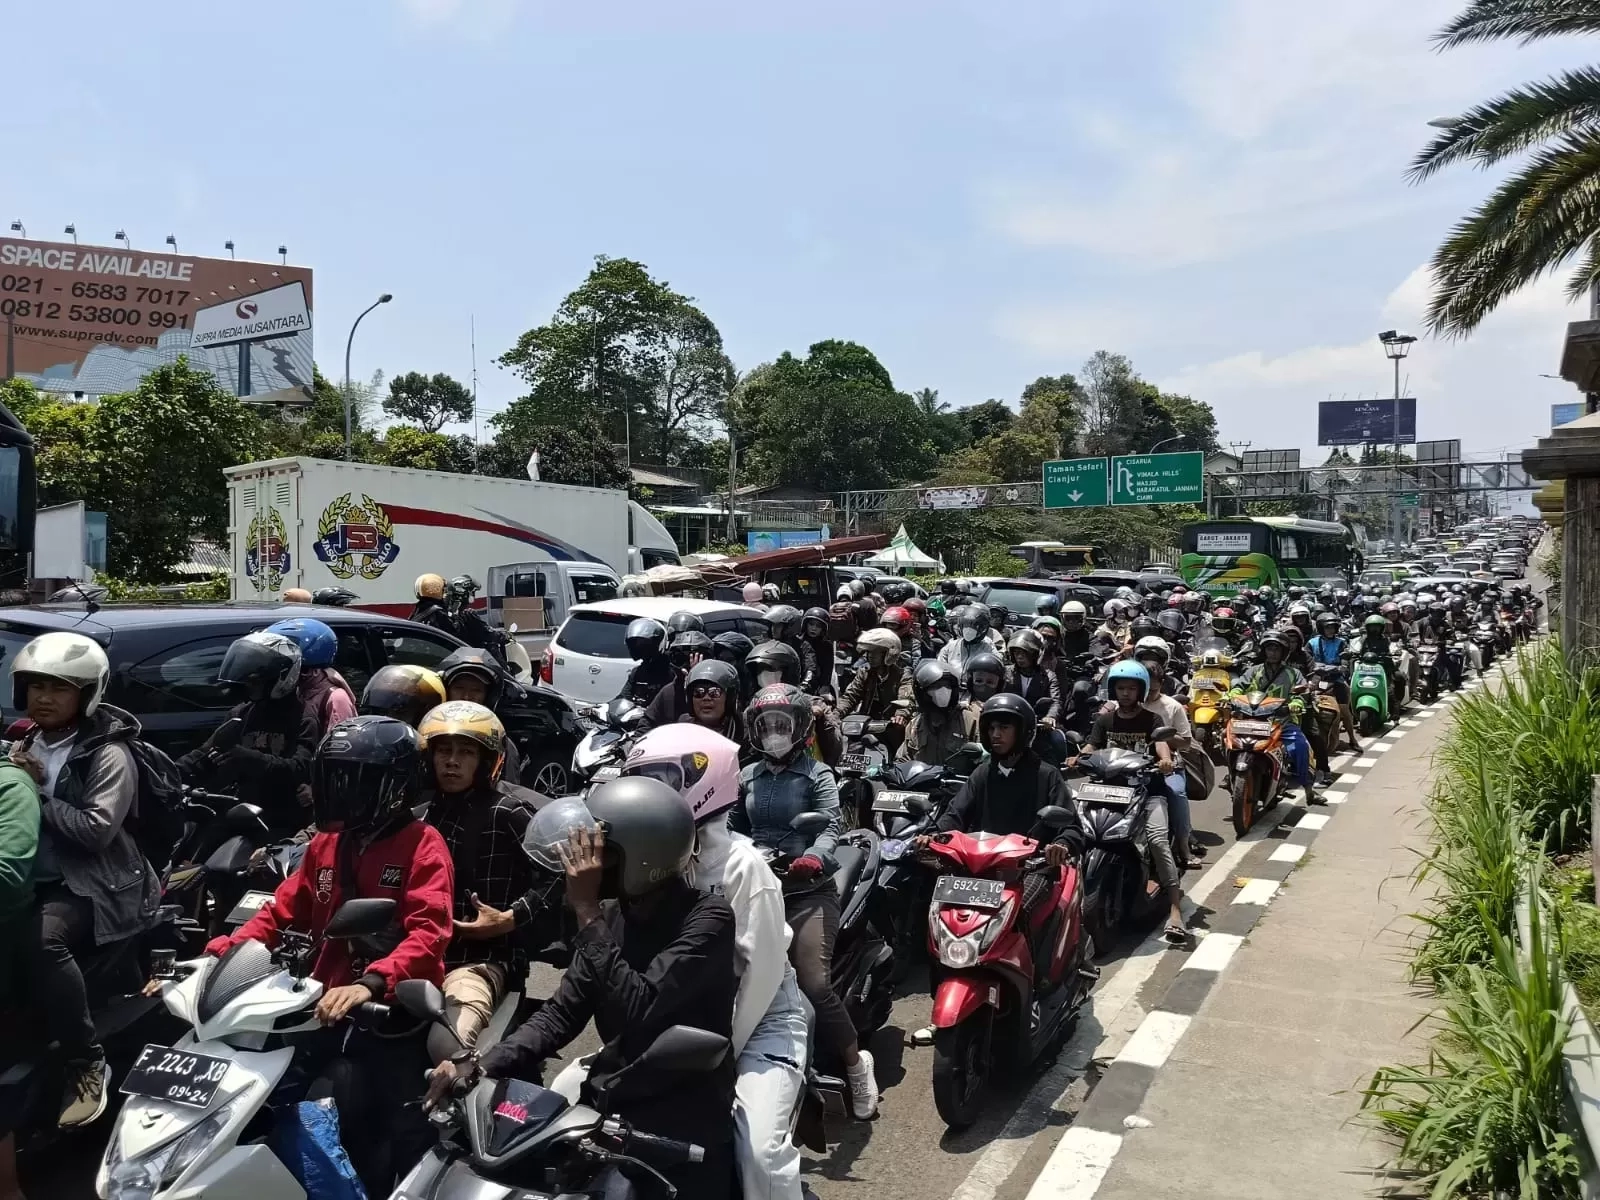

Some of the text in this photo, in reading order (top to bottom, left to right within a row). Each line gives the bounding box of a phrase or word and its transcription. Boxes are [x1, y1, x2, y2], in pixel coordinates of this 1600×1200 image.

[0, 244, 194, 282] SPACE AVAILABLE
[1, 275, 44, 294] 021
[71, 281, 127, 302] 6583
[136, 287, 191, 306] 7017
[0, 298, 189, 330] 0812 53800 991
[195, 314, 304, 343] SUPRA MEDIA NUSANTARA
[14, 325, 158, 345] www.supradv.com
[1048, 474, 1080, 484] Cianjur
[1077, 462, 1103, 471] Safari
[938, 878, 1003, 894] F 6924 YC
[135, 1049, 229, 1082] F 2243 XB
